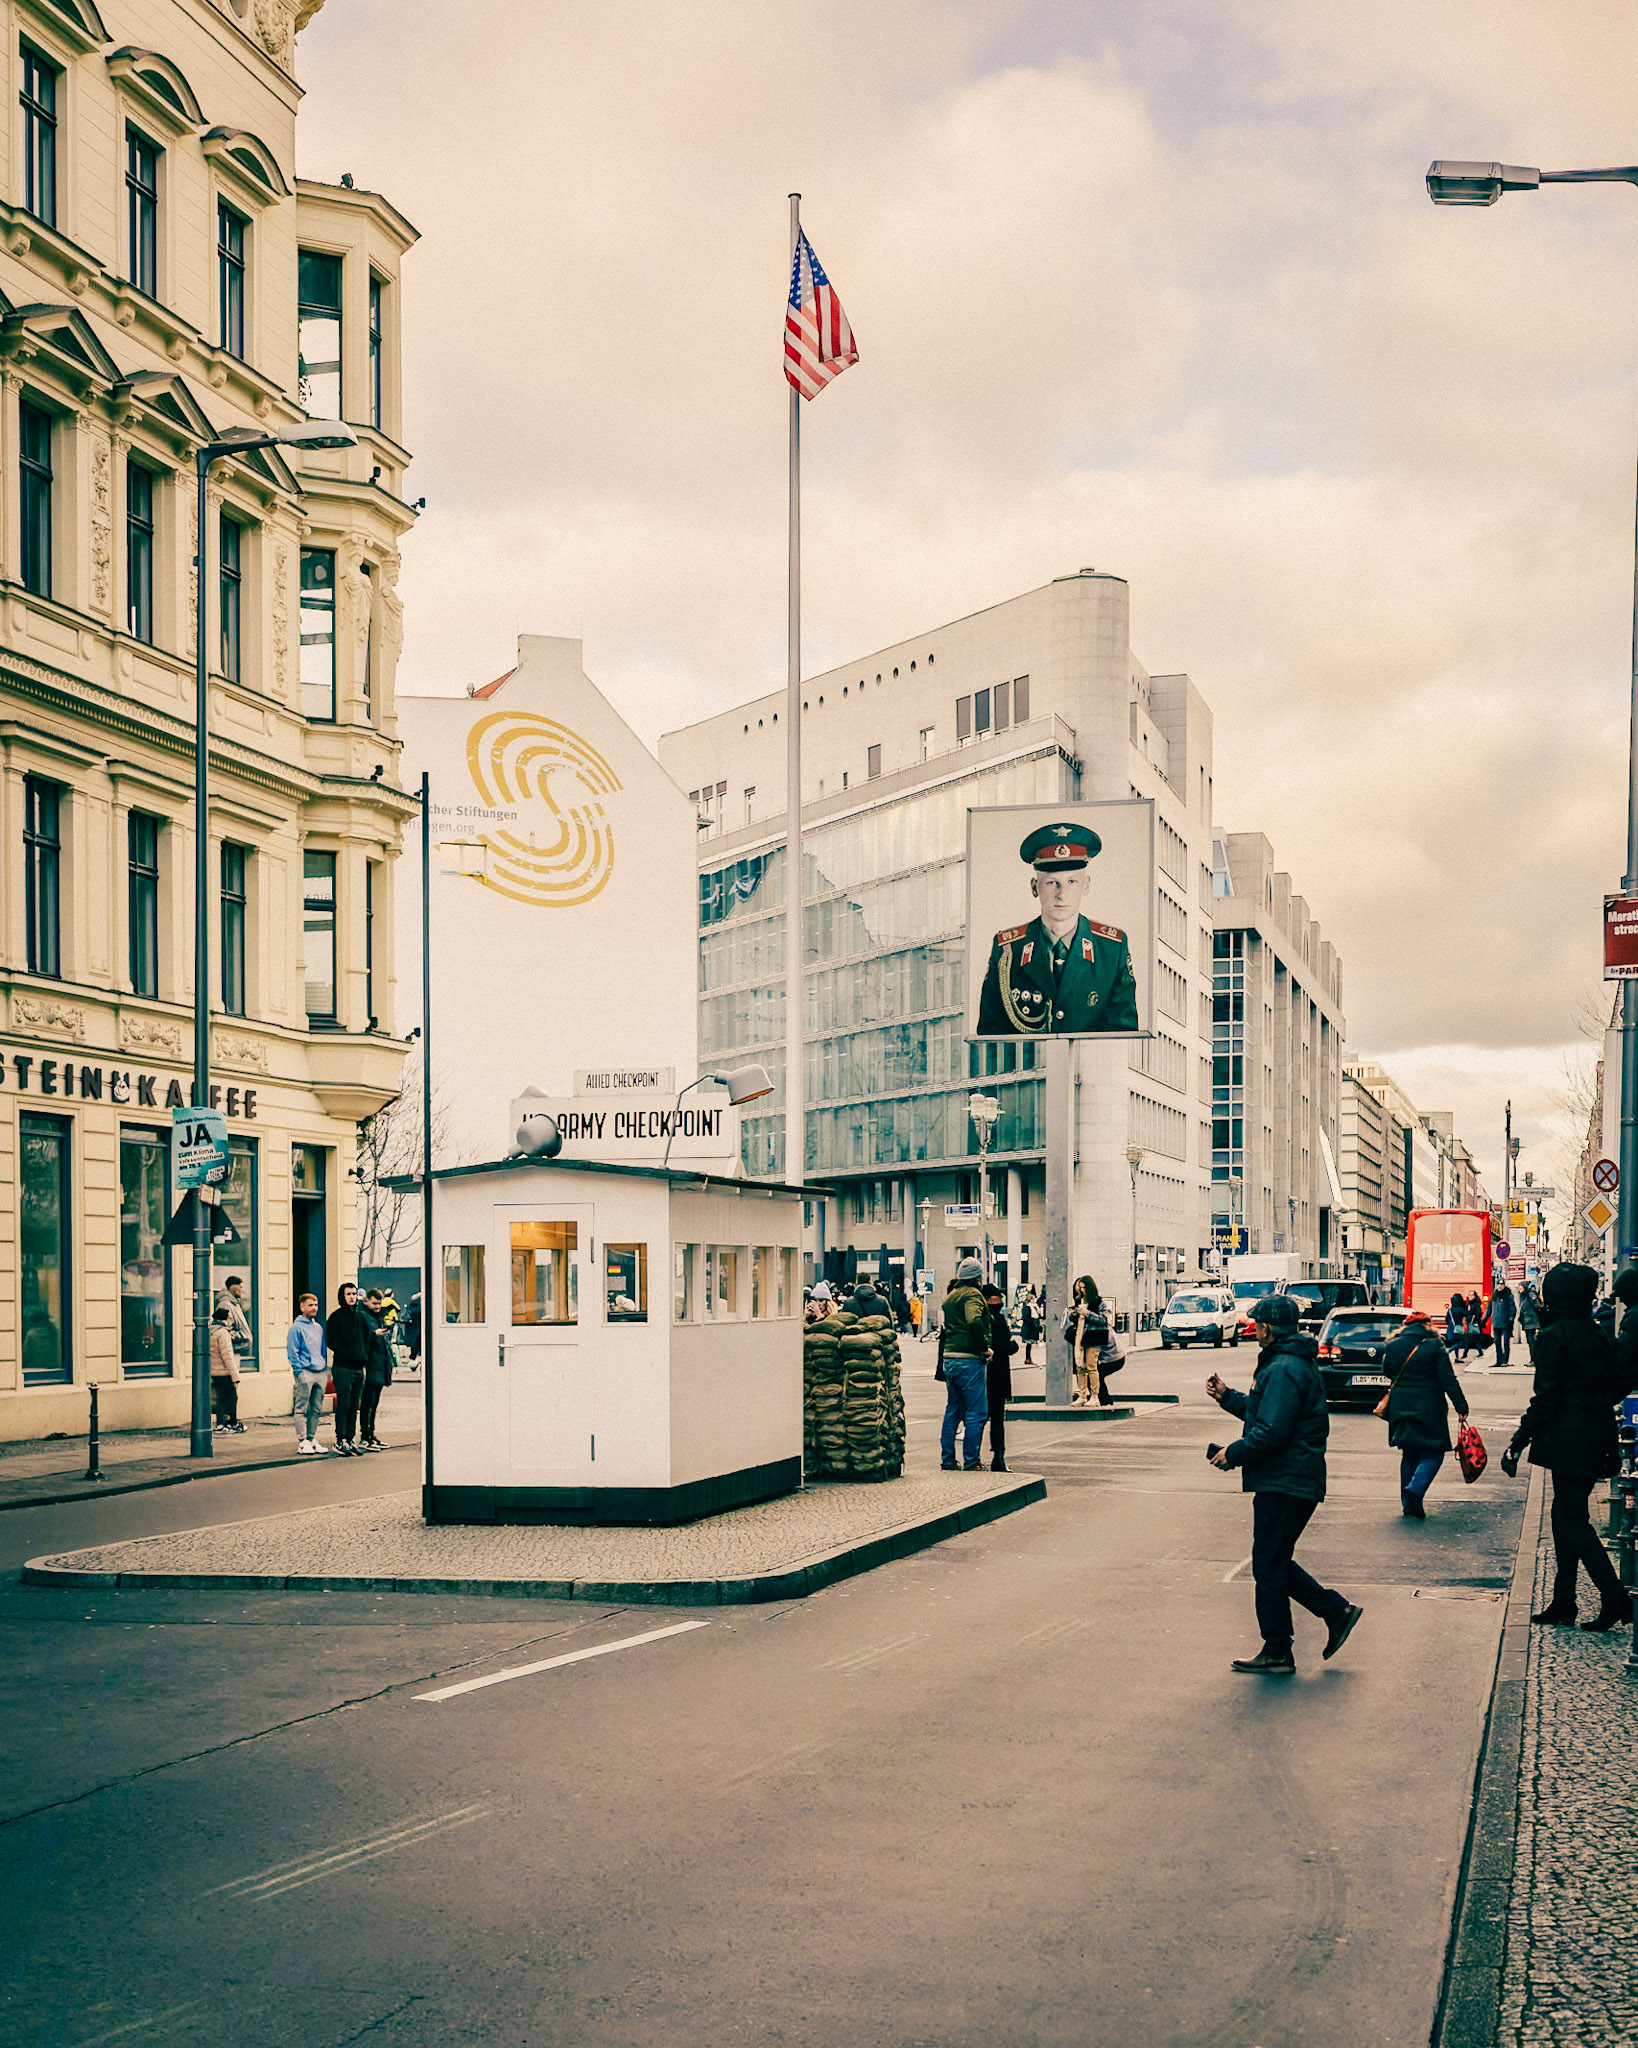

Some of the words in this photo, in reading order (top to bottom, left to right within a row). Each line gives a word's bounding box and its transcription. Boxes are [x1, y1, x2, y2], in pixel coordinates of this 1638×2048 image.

[429, 804, 452, 815] cher
[457, 806, 517, 821] Stiftungen
[0, 1052, 103, 1100] TEIN
[138, 1074, 257, 1118] KAFEE
[586, 1073, 610, 1089] ALLIED
[613, 1071, 659, 1088] CHECKPOINT
[180, 1123, 213, 1148] JA
[557, 1112, 607, 1139] ARMY
[614, 1109, 723, 1138] CHECKPOINT
